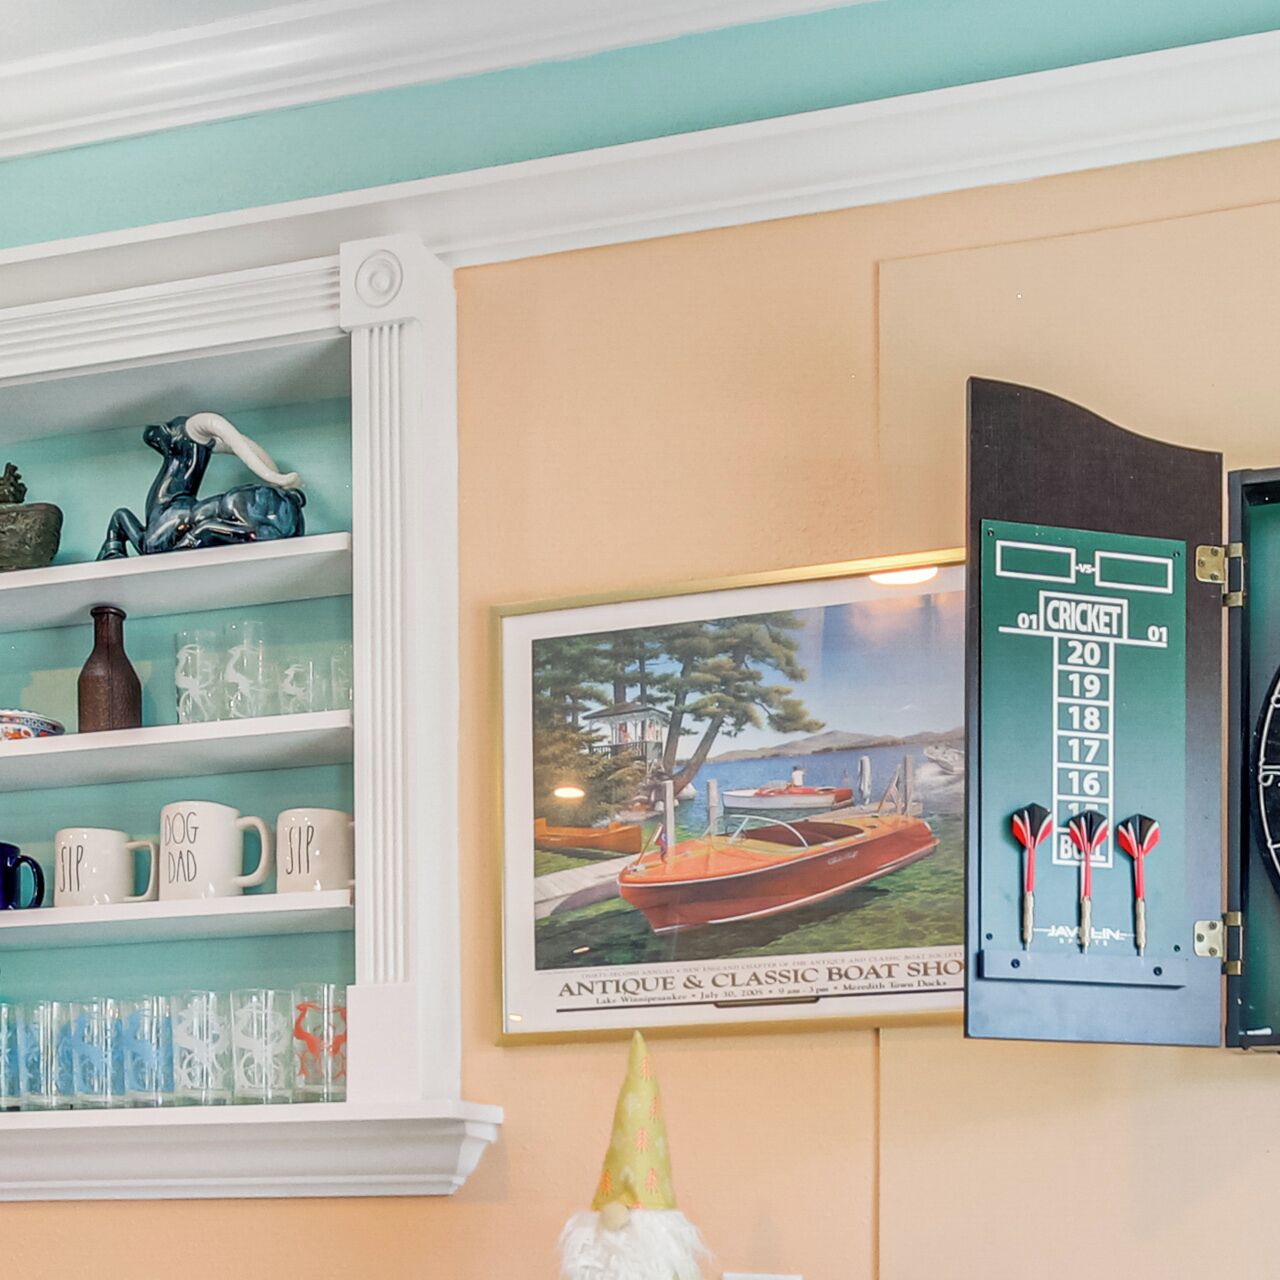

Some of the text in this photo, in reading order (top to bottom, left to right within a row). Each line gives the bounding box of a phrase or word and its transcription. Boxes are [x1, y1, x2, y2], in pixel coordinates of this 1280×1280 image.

[1017, 612, 1038, 630] 01
[1046, 599, 1121, 636] CRICKET
[1147, 625, 1168, 643] 01
[1067, 640, 1101, 666] 20
[1068, 673, 1101, 698] 19
[1068, 705, 1101, 731] 18
[1068, 738, 1100, 763] 17
[1068, 771, 1101, 796] 16
[164, 811, 199, 846] DOG
[285, 824, 314, 875] SIP
[60, 845, 84, 893] SIP
[168, 850, 197, 884] DAD
[1048, 925, 1124, 940] JAVLIN
[558, 976, 675, 997] ANTIQUE
[683, 974, 703, 989] &
[711, 967, 819, 989] CLASSIC
[827, 963, 899, 982] BOAT
[596, 996, 617, 1005] Lake
[700, 991, 719, 1001] July
[842, 982, 886, 992] Meredith
[917, 979, 948, 988] Docks
